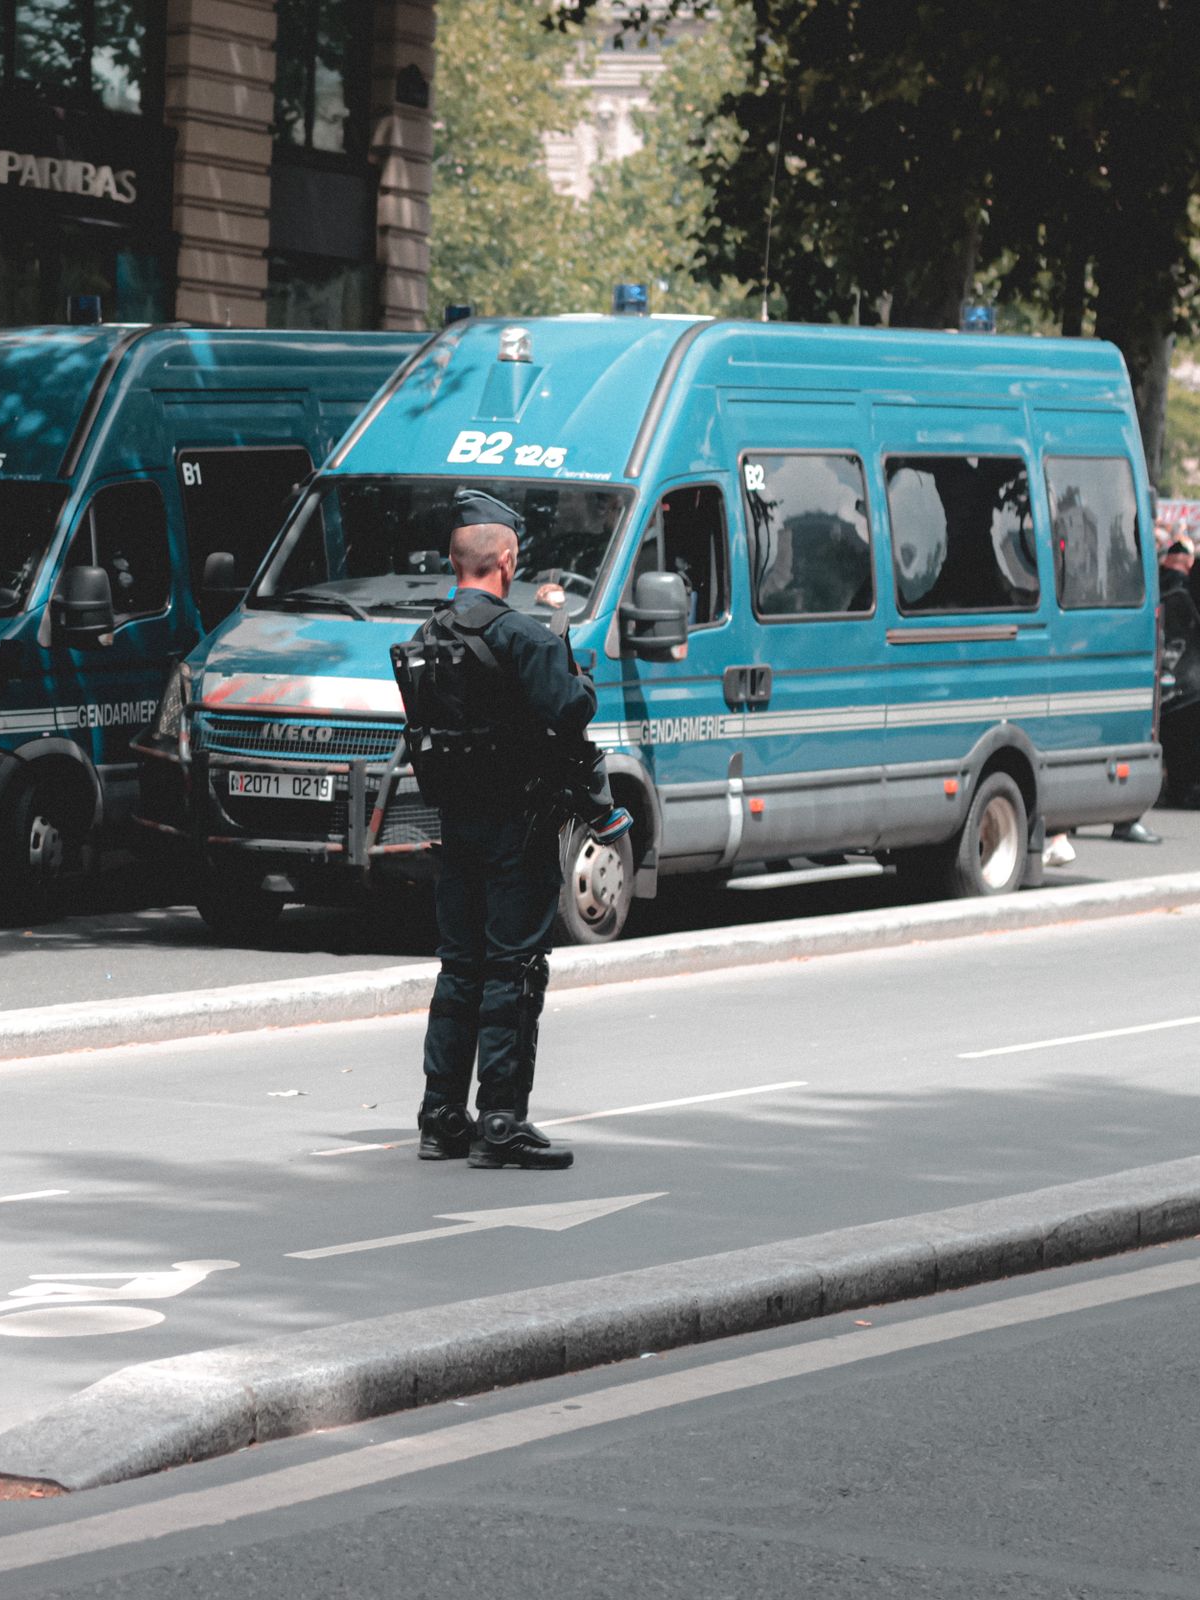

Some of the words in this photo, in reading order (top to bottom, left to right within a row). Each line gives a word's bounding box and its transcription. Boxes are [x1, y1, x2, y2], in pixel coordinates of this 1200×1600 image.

[446, 430, 513, 464] B2
[514, 445, 568, 468] 12/5
[182, 461, 202, 486] B1
[744, 464, 766, 490] B2
[261, 722, 333, 742] IVECO
[640, 715, 725, 745] GENDARMERIE
[243, 774, 280, 795] 2071
